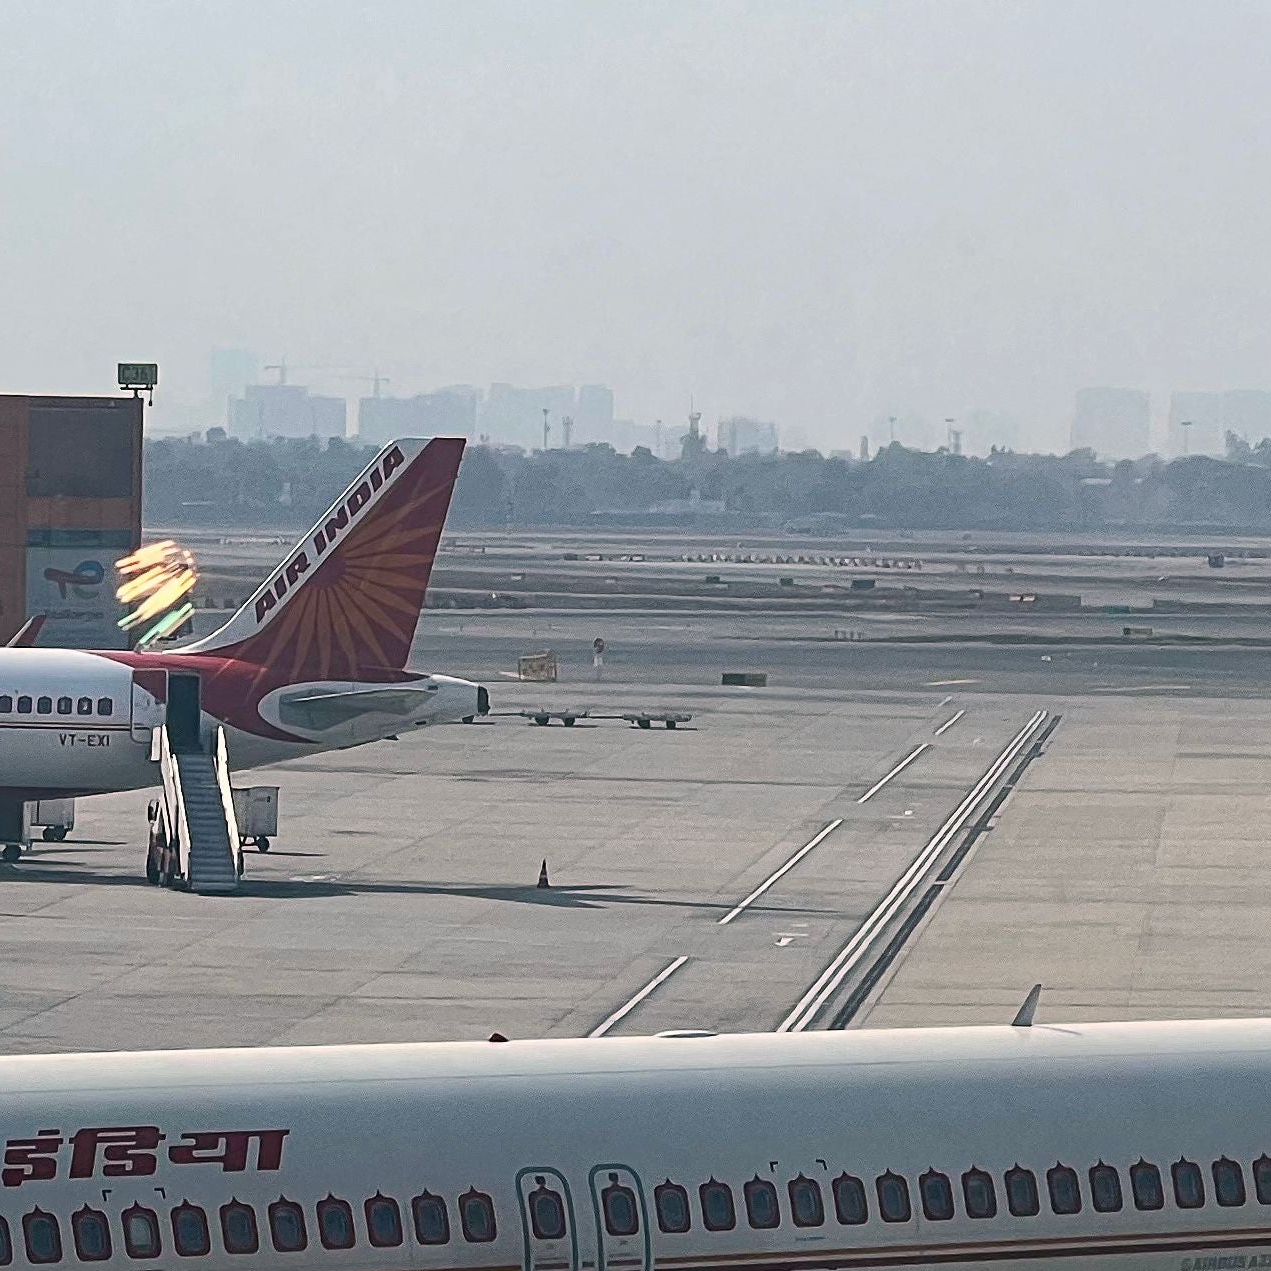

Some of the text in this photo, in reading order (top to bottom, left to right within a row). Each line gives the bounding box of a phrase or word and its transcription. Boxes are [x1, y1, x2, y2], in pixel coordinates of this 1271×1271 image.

[255, 445, 405, 624] AIR INDIA
[59, 734, 110, 747] VT-EXI
[0, 1125, 291, 1188] इंडिया
